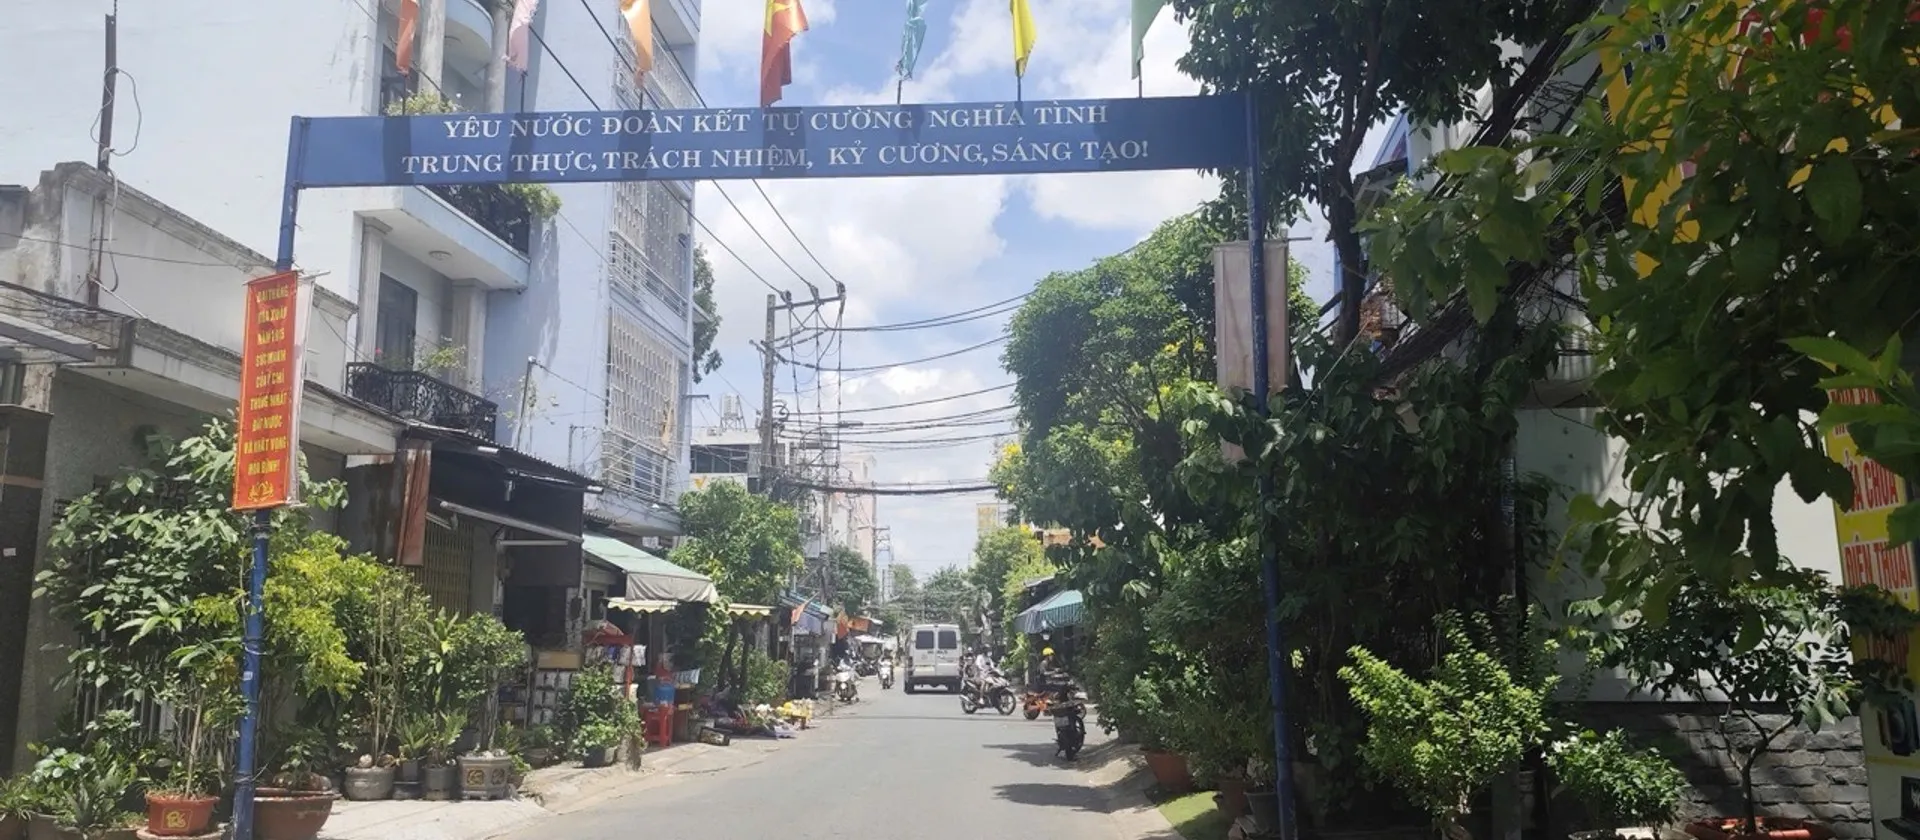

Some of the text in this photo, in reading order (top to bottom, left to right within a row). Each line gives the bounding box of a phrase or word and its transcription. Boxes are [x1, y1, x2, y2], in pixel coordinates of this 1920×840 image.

[444, 100, 1109, 138] YÊU NƯỚC ĐOÀN KẾT TỰ CƯỜNG NGHĨA TÌNH
[402, 154, 504, 175] TRUNG
[510, 150, 597, 177] THỰC,
[602, 146, 703, 170] TRÁCH
[710, 144, 813, 171] NHIỆM,
[828, 140, 869, 165] KỶ
[991, 136, 1073, 162] SÁNG
[1080, 139, 1149, 165] TẠO!
